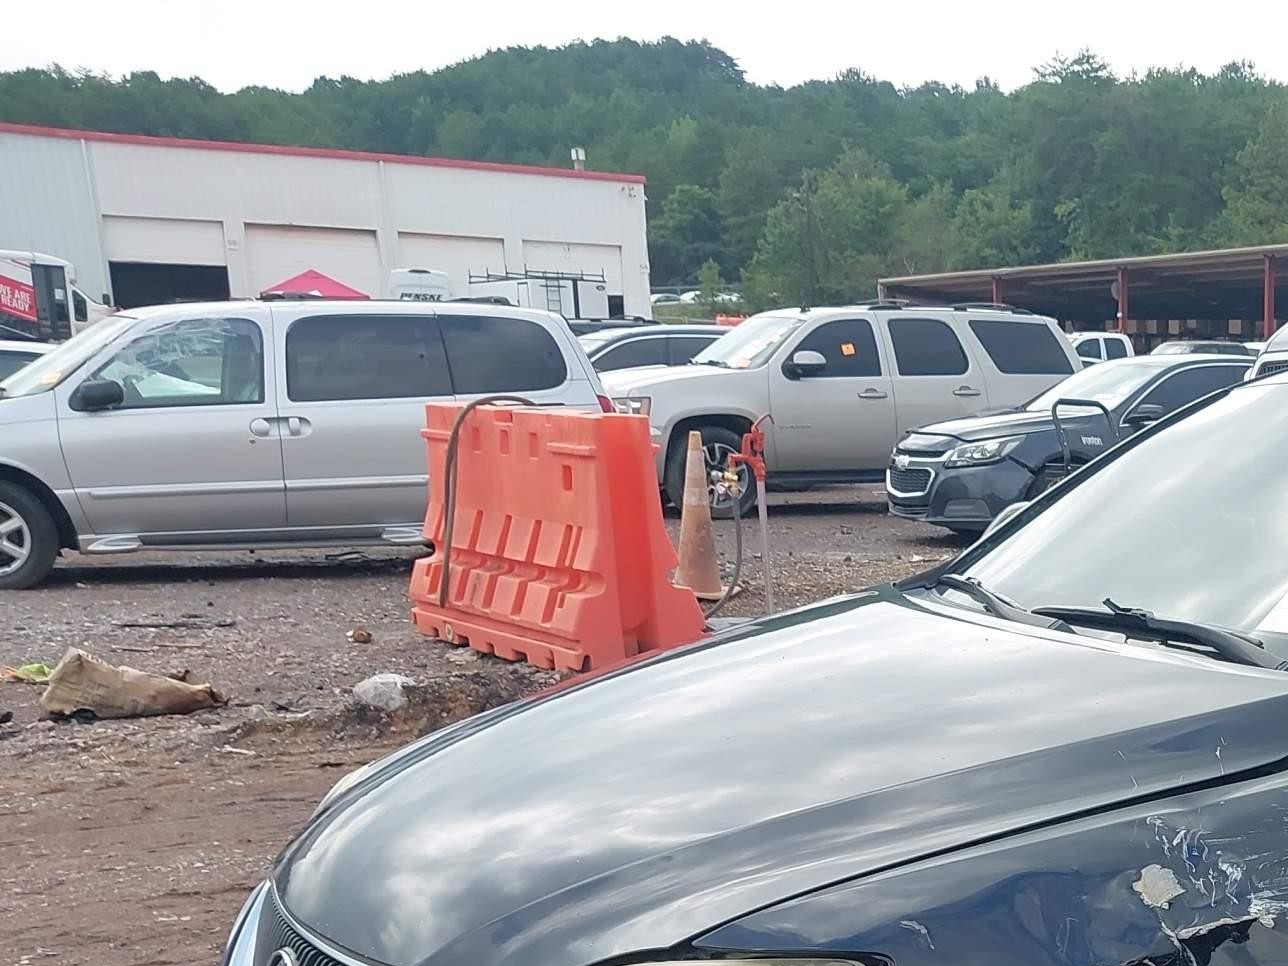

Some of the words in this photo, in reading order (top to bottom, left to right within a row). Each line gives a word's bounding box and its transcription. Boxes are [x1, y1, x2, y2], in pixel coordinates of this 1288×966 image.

[1, 294, 29, 312] READY
[14, 289, 31, 304] ARE
[400, 291, 443, 301] PENSKE
